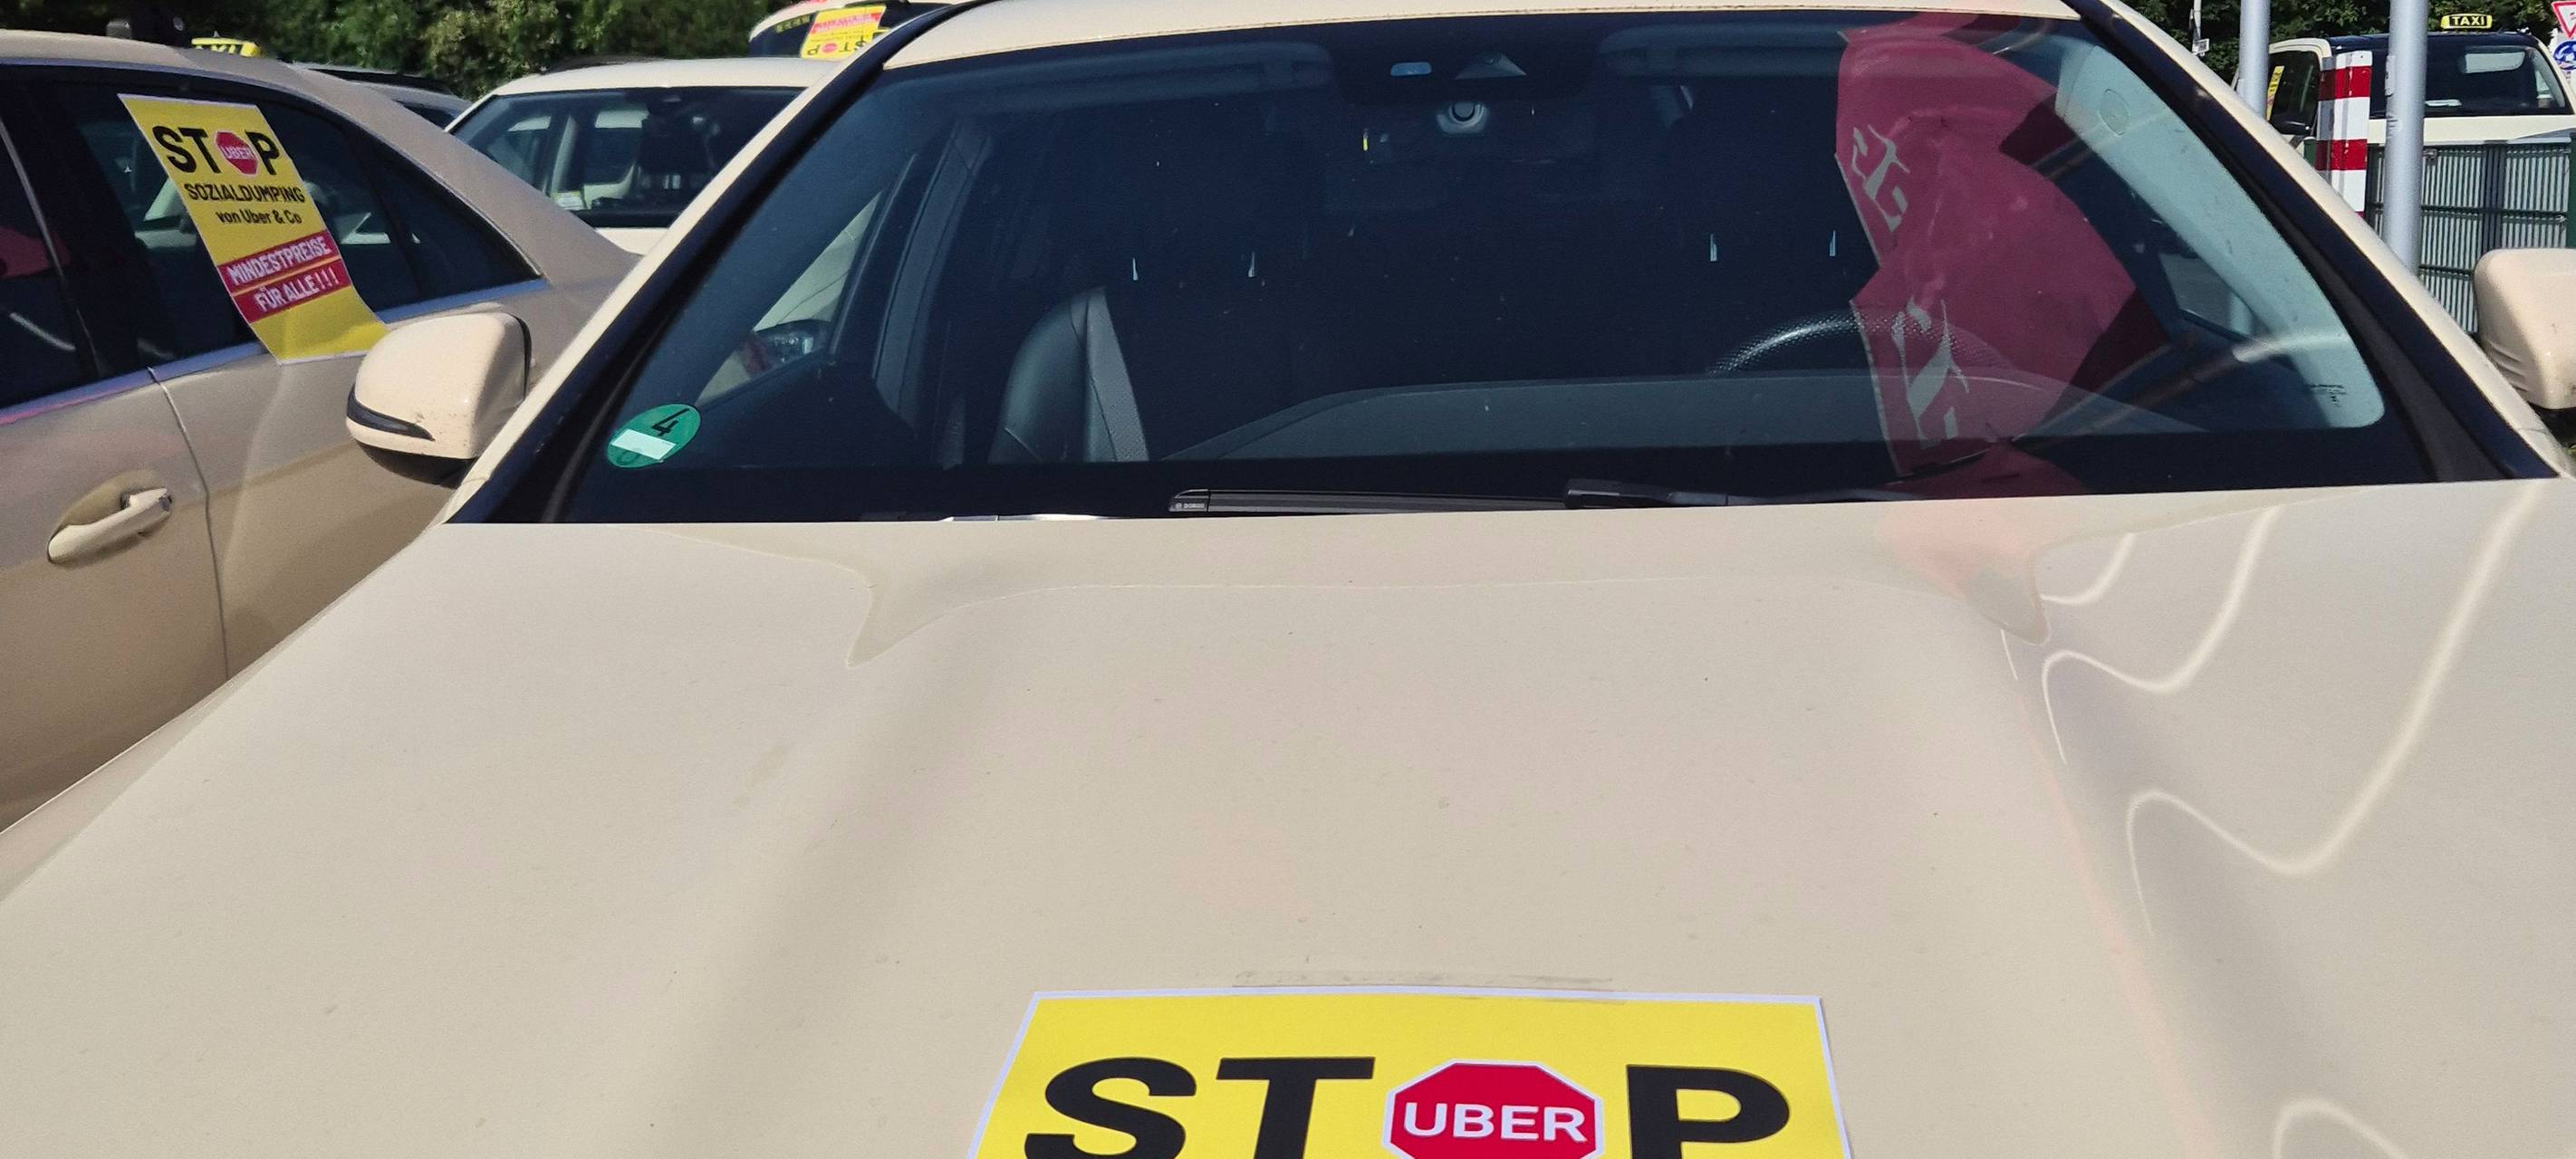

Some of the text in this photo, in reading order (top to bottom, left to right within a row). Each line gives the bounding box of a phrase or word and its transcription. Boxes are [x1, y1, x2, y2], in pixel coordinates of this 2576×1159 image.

[2451, 15, 2485, 26] TAXI
[151, 125, 280, 176] STOP
[219, 145, 254, 160] UBER
[184, 183, 305, 203] SOZIALDUMPING
[216, 208, 303, 224] von Uber & Co
[226, 235, 332, 286] MINDESTPREISE
[254, 285, 288, 312] FÜR
[650, 407, 690, 436] 4
[1404, 1101, 1588, 1143] UBER
